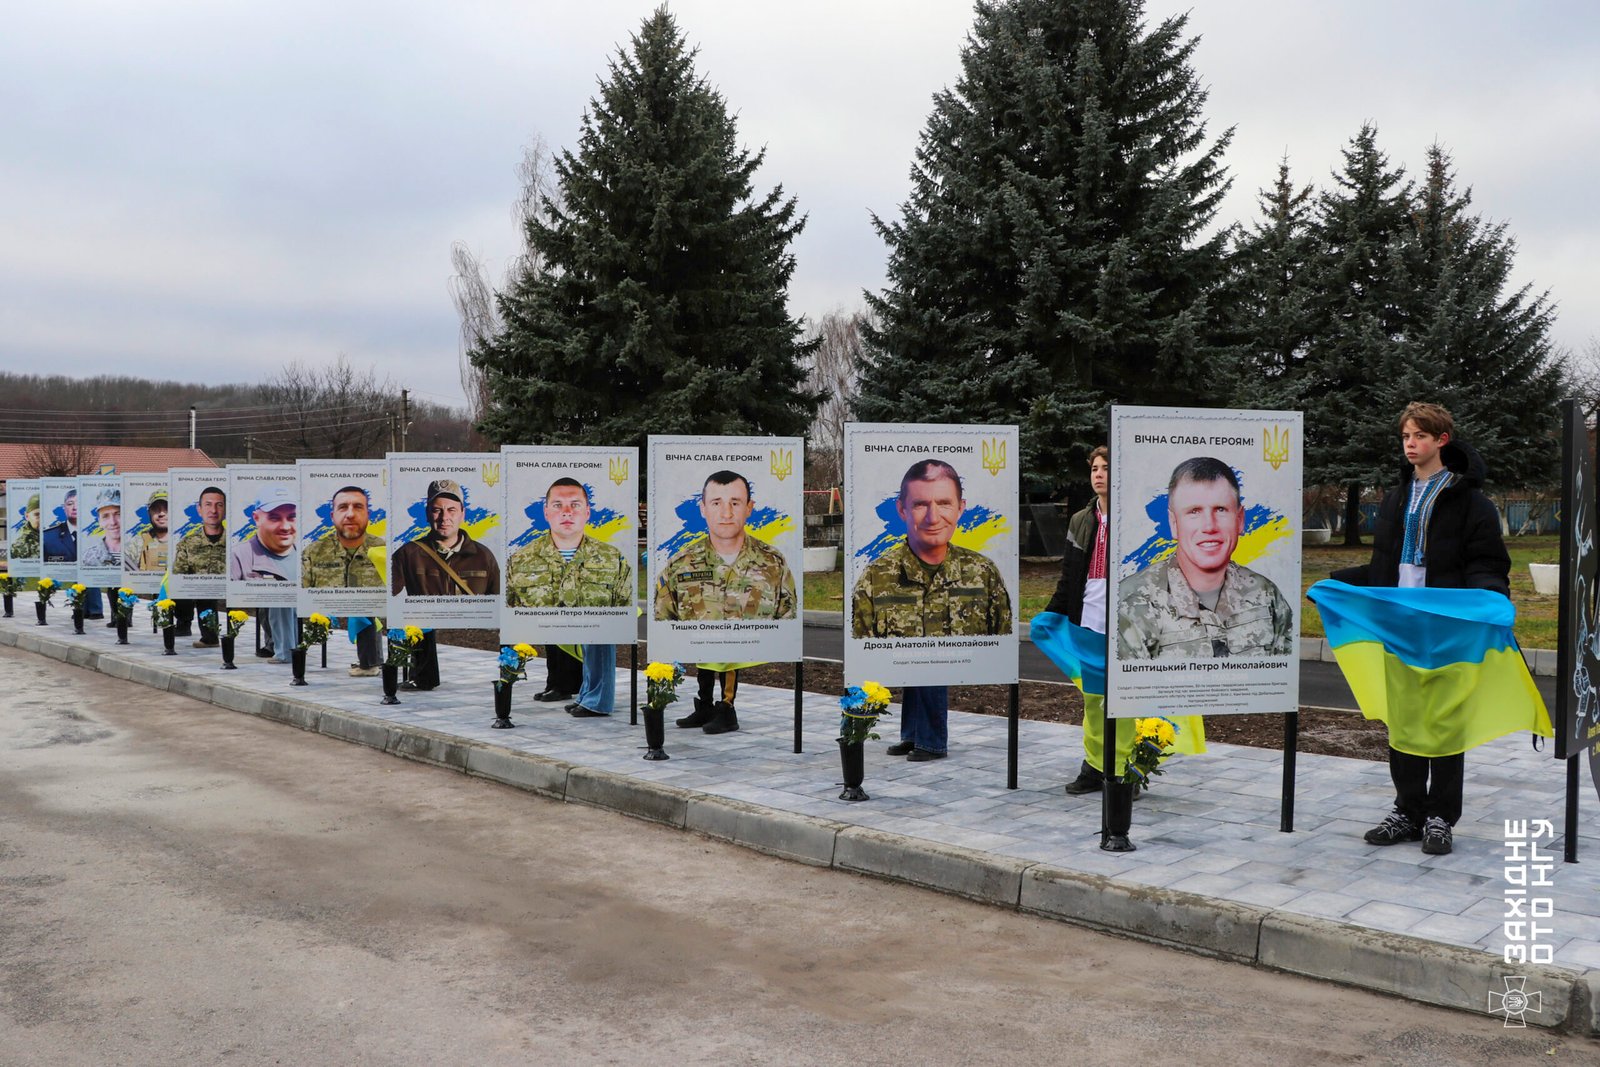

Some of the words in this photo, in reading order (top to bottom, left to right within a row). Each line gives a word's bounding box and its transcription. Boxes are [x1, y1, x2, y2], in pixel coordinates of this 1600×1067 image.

[1134, 435, 1167, 444] ВІЧНА
[1170, 436, 1206, 445] СЛАВА
[1210, 437, 1254, 446] ГЕРОЯМ!
[864, 642, 893, 650] Дрозд
[895, 640, 935, 649] Анатолій
[1122, 663, 1187, 673] Шептицький
[1189, 662, 1218, 672] Петро
[1222, 661, 1288, 670] Миколайович
